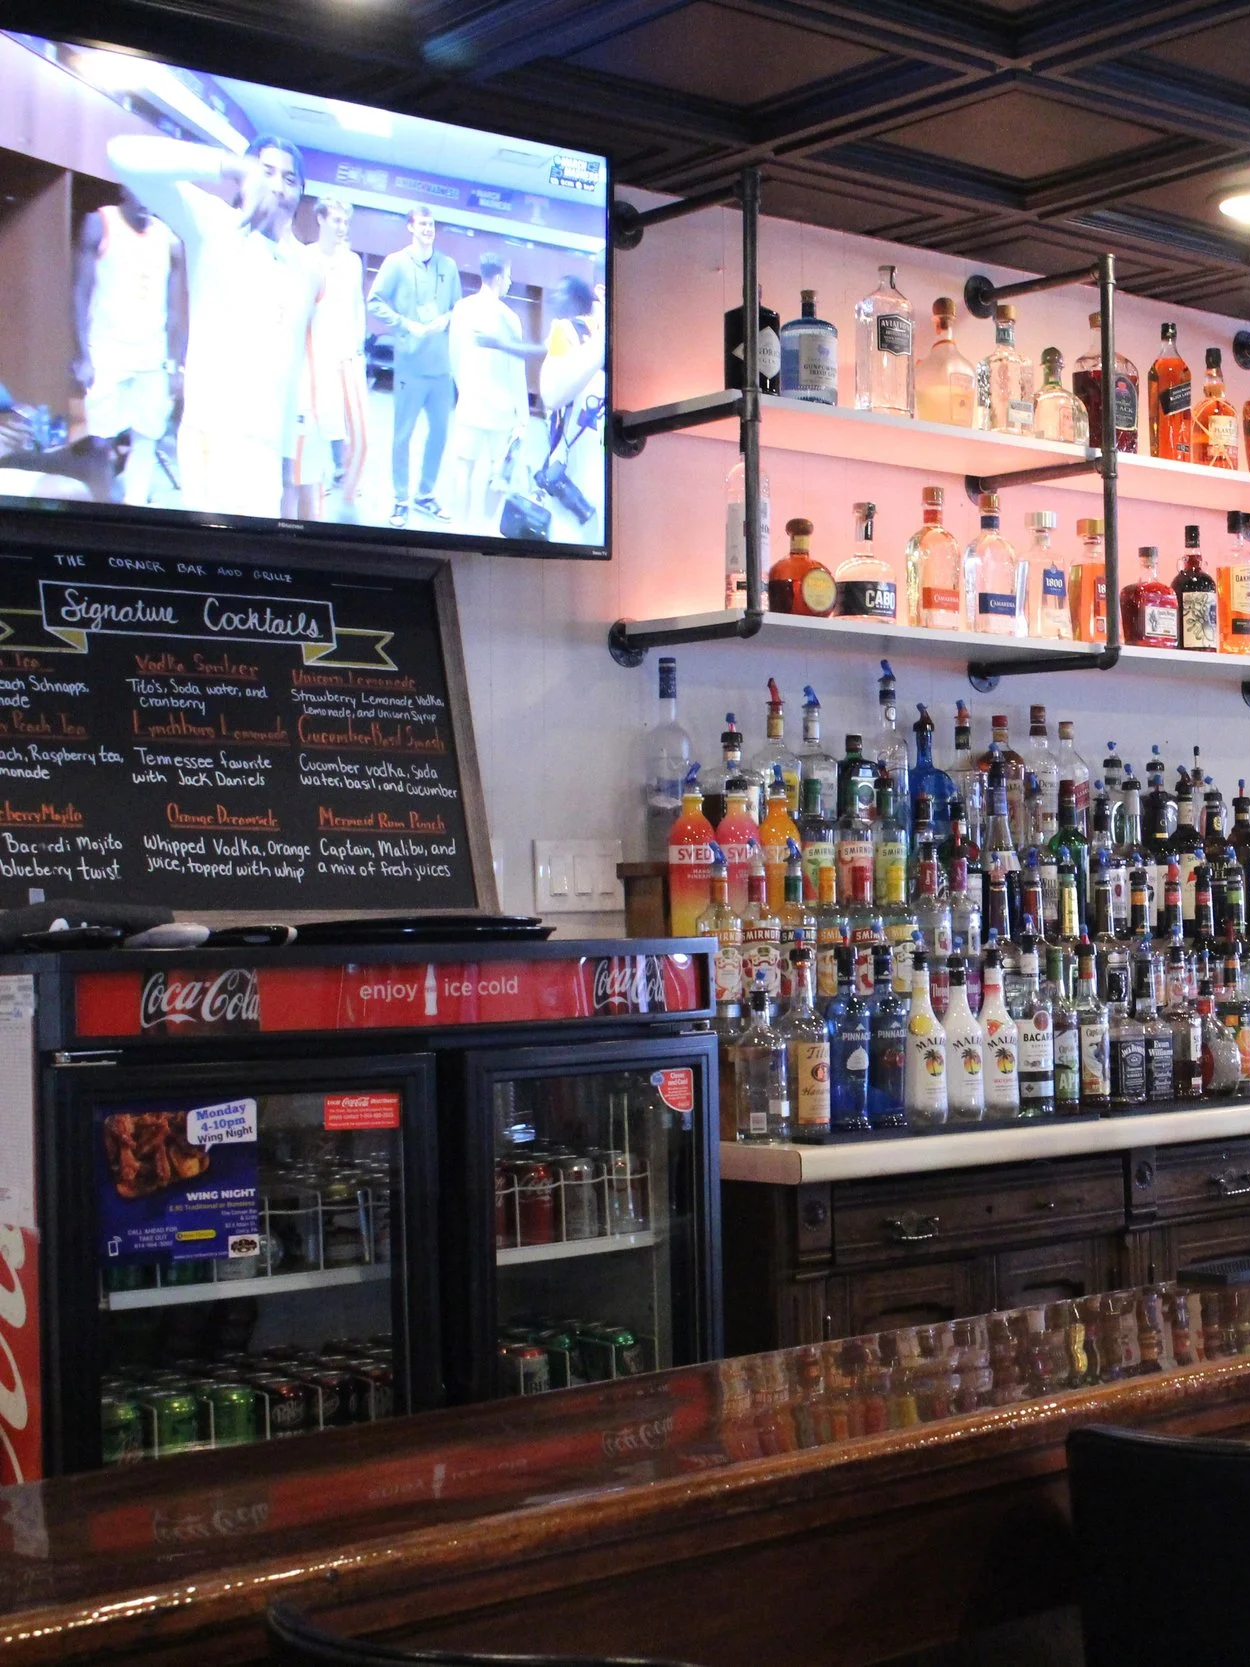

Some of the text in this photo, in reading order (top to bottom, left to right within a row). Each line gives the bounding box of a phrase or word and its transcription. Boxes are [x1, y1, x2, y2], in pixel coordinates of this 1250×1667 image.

[54, 554, 86, 567] THE
[108, 558, 165, 572] CORNER
[177, 564, 207, 576] BAR
[217, 566, 242, 577] AND
[1045, 578, 1063, 588] 1800
[865, 590, 895, 610] CABO
[61, 589, 324, 638] Signature Cocktails
[245, 686, 268, 699] and
[290, 689, 356, 708] Strawberry
[361, 692, 414, 708] Lemonade
[357, 709, 375, 718] and
[28, 744, 96, 766] Raspberry
[133, 747, 272, 769] Tennessee favorite
[299, 753, 360, 774] Cucumber
[132, 770, 167, 784] with
[216, 770, 266, 787] Daniels
[383, 781, 404, 793] and
[76, 833, 123, 856] Mojito
[144, 834, 205, 857] Whipped
[320, 838, 457, 860] Captain, Malibu, and
[678, 848, 711, 860] SVED
[187, 857, 232, 878] topped
[236, 859, 271, 876] with
[275, 861, 305, 883] whip
[318, 861, 451, 881] a mix of fresh juices
[141, 968, 261, 1029] Coca-Cola
[359, 976, 519, 1003] enjoy ice cold
[196, 1104, 246, 1120] Monday
[201, 1117, 246, 1132] 4-10pm
[197, 1126, 253, 1144] Wing Night
[186, 1188, 256, 1202] WING NIGHT
